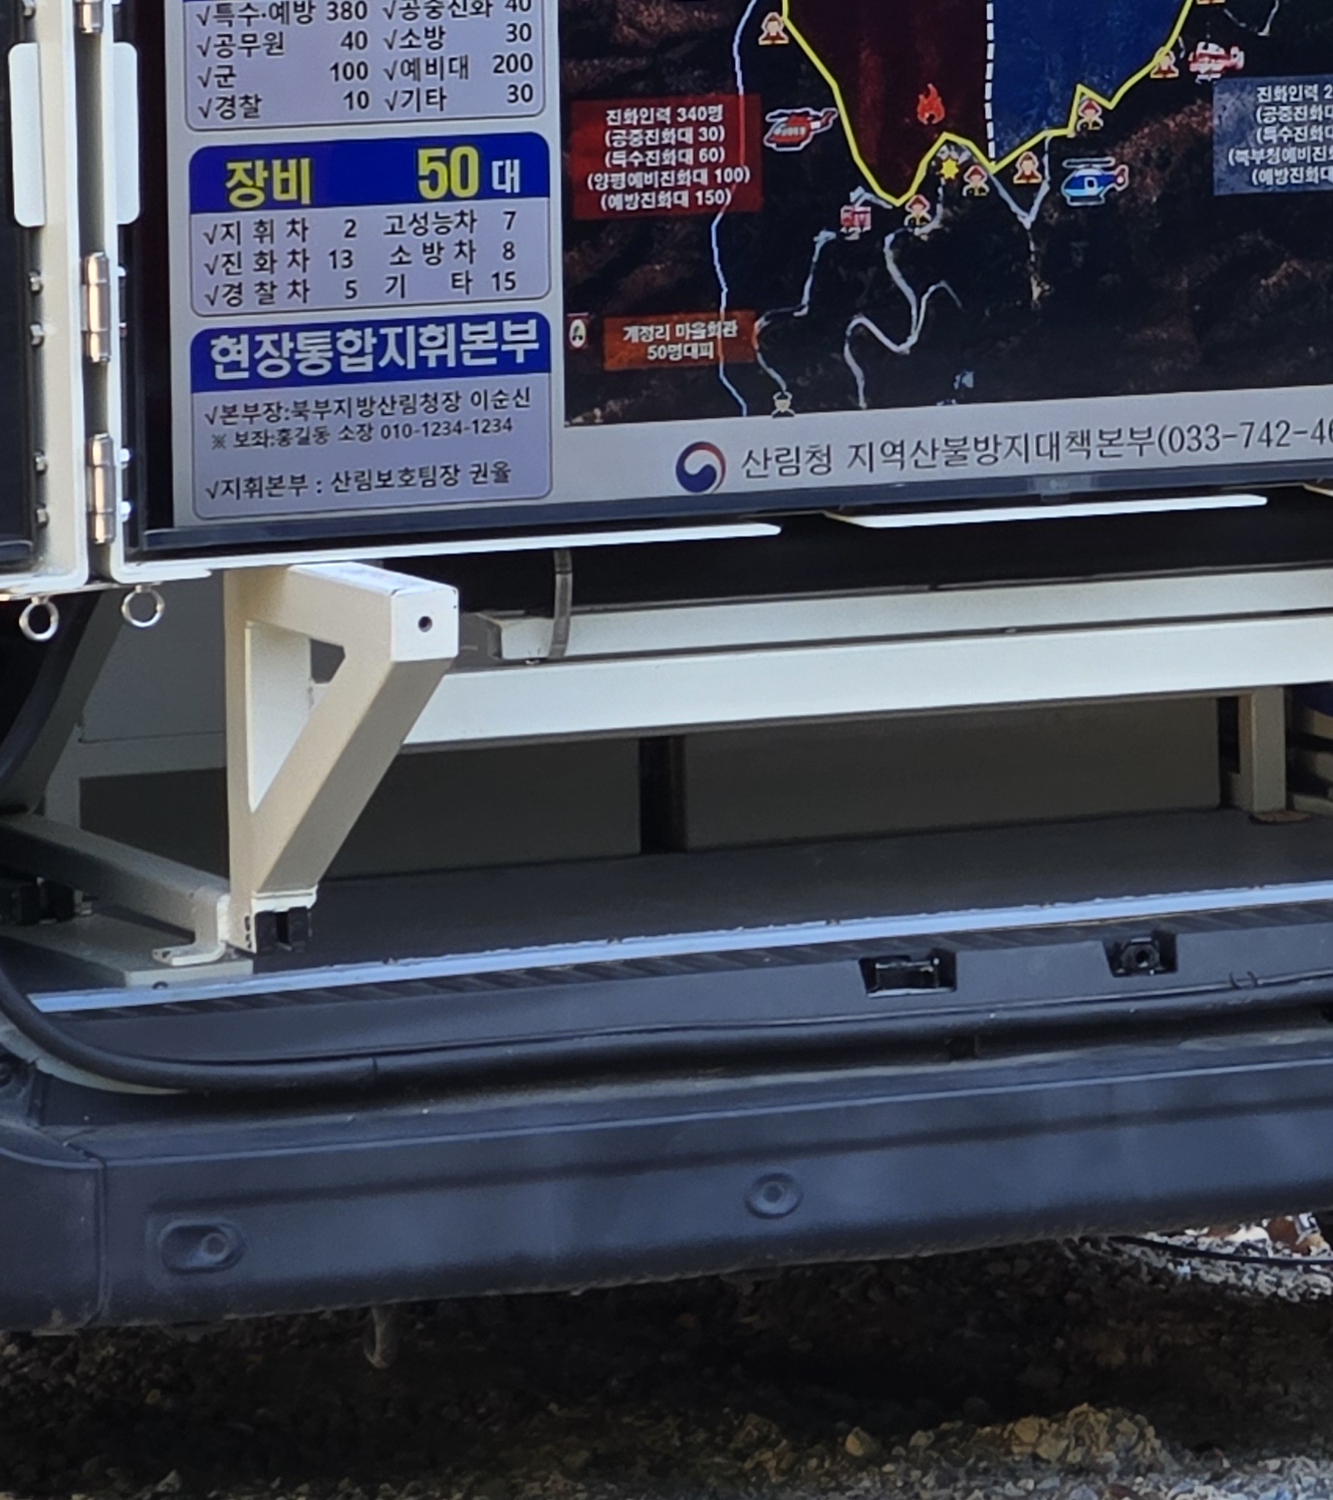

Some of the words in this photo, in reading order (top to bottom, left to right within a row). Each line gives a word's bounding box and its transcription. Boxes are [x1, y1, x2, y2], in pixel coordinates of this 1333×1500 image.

[325, 0, 368, 21] 380
[340, 32, 368, 52] 40
[505, 23, 532, 43] 30
[329, 62, 369, 82] 100
[493, 54, 534, 74] 200
[344, 91, 370, 111] 10
[507, 84, 534, 104] 30
[1256, 83, 1319, 102] 진화인력
[605, 105, 672, 125] 진화인력
[676, 104, 723, 123] 340명
[698, 124, 725, 143] 30)
[225, 158, 312, 209] 장비
[417, 146, 480, 198] 50
[492, 159, 521, 194] 대
[714, 165, 750, 185] 100)
[695, 188, 732, 208] 150)
[344, 219, 357, 239] 2
[384, 209, 478, 237] 고성능차
[503, 211, 517, 231] 7
[328, 249, 354, 270] 13
[502, 241, 516, 261] 8
[345, 280, 358, 300] 5
[491, 271, 517, 291] 15
[623, 322, 671, 343] 계정리
[209, 318, 540, 382] 현장통합지휘본부
[647, 342, 714, 361] 50명대피
[470, 387, 531, 412] 이순신
[337, 423, 373, 444] 소장
[380, 417, 513, 441] 010-1234-1234
[740, 443, 834, 480] 산림청
[330, 463, 461, 493] 산림보호팀장
[469, 460, 511, 486] 권율
